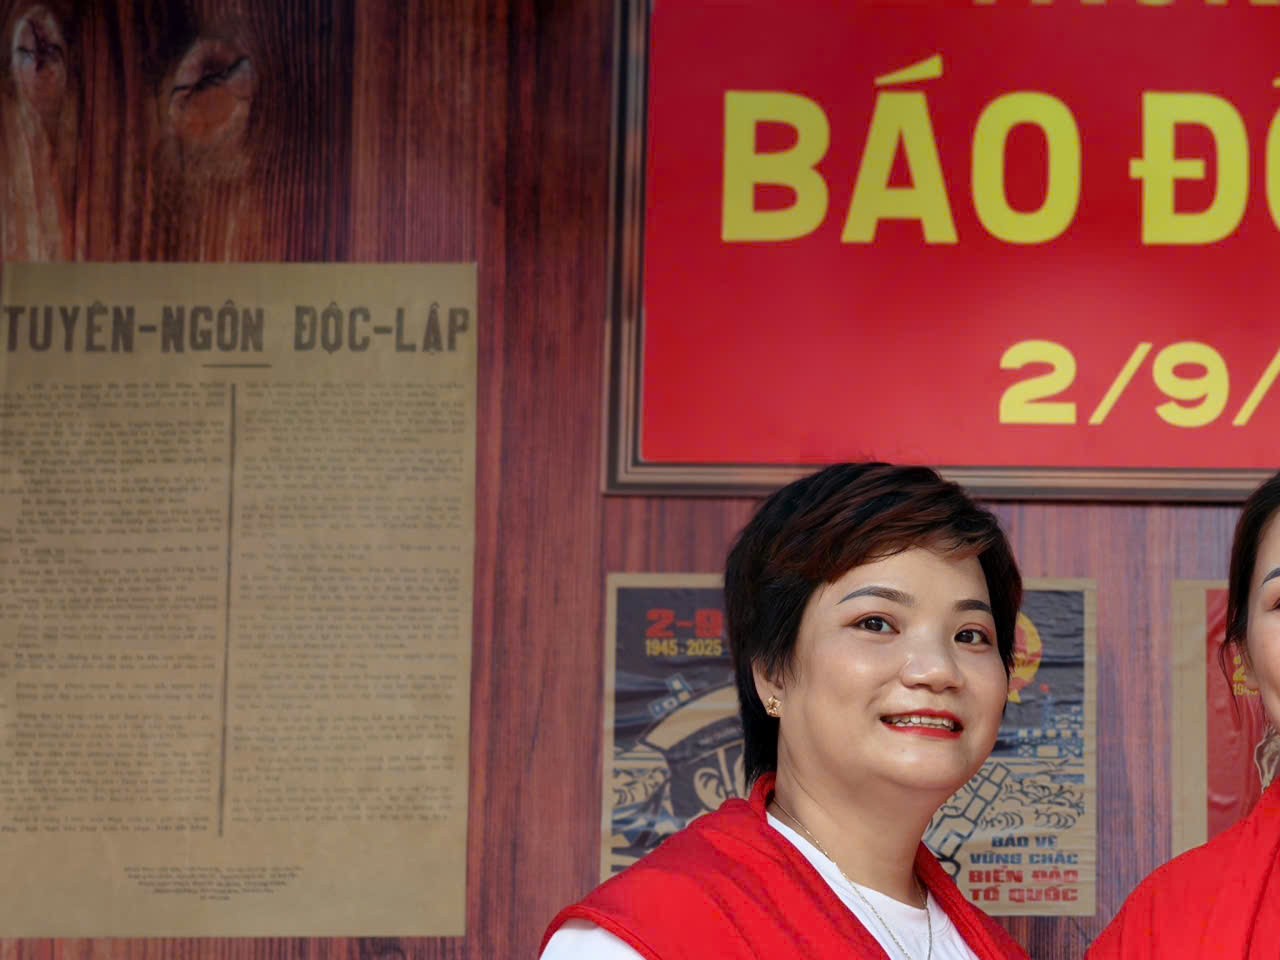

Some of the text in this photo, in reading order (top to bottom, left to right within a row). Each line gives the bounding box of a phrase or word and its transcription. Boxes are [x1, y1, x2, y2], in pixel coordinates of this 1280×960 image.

[721, 54, 1082, 244] BÁO
[3, 298, 470, 355] TUYÊN-NGÔN ĐỘC-LẬP
